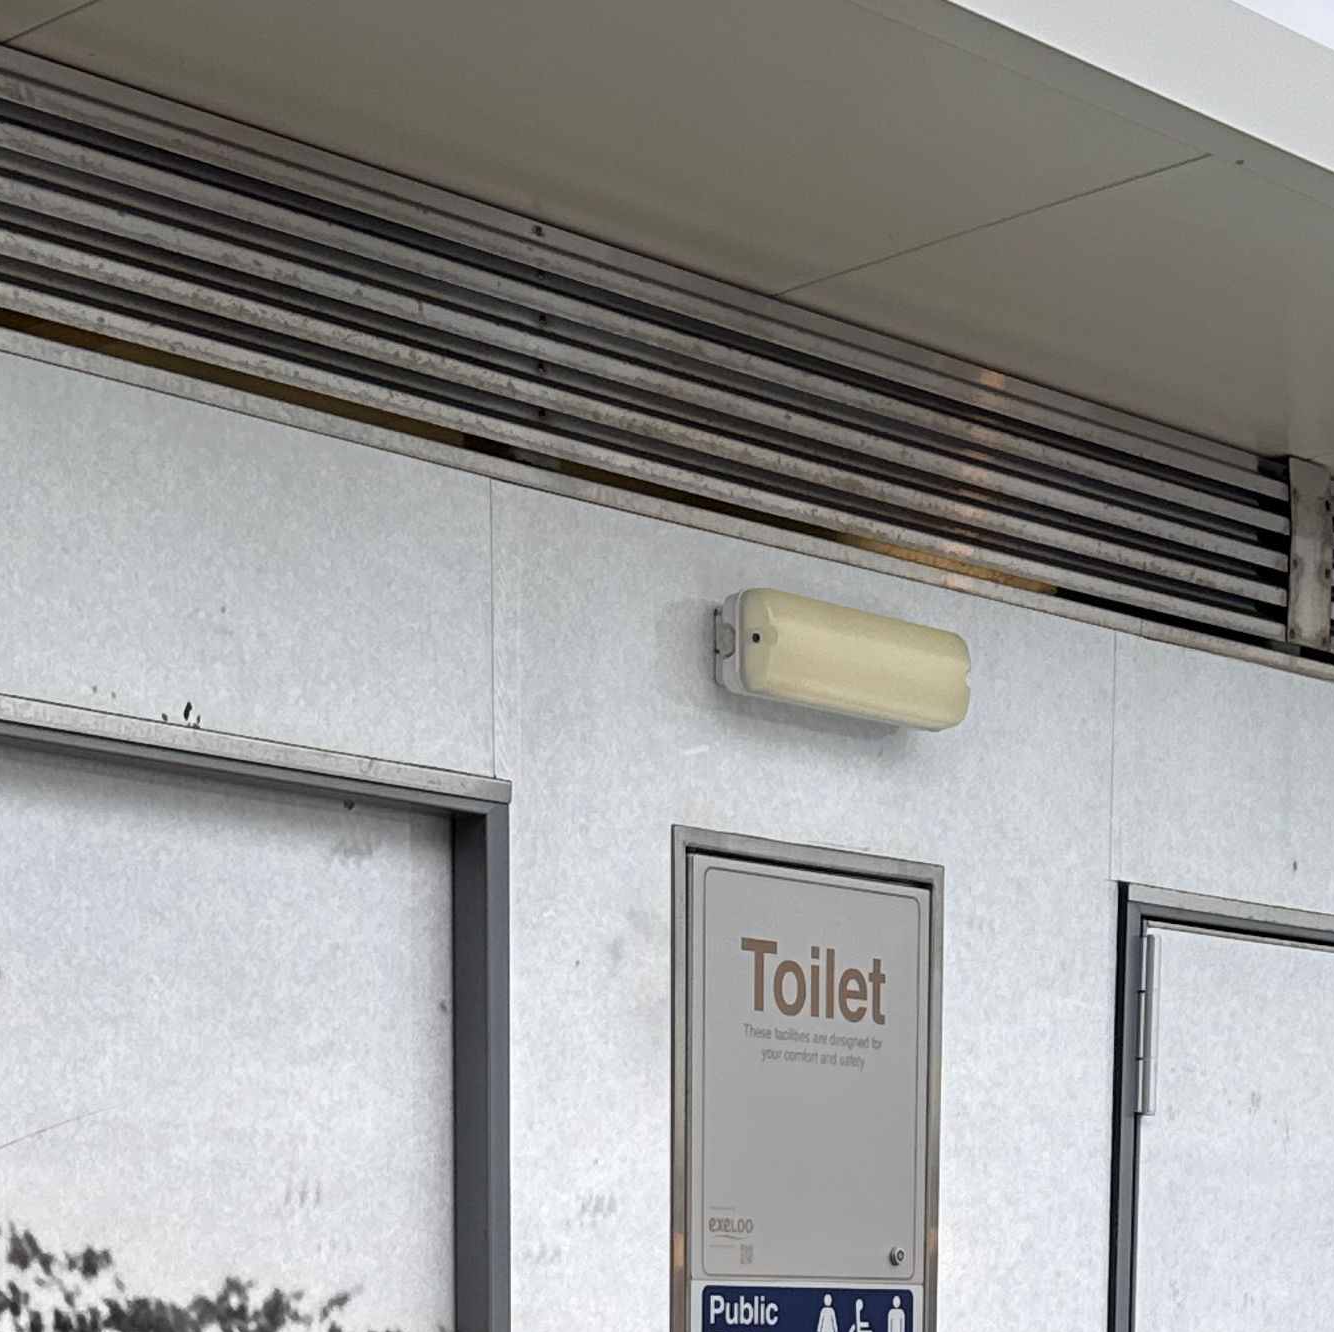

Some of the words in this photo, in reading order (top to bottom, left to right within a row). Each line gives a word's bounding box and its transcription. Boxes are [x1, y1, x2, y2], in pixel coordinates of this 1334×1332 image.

[741, 936, 886, 1025] Toilet
[743, 1023, 772, 1040] These
[812, 1034, 827, 1045] are
[830, 1032, 869, 1051] designed
[761, 1049, 781, 1062] your
[784, 1049, 818, 1063] comfort
[820, 1052, 837, 1066] and
[709, 1294, 779, 1326] Public
